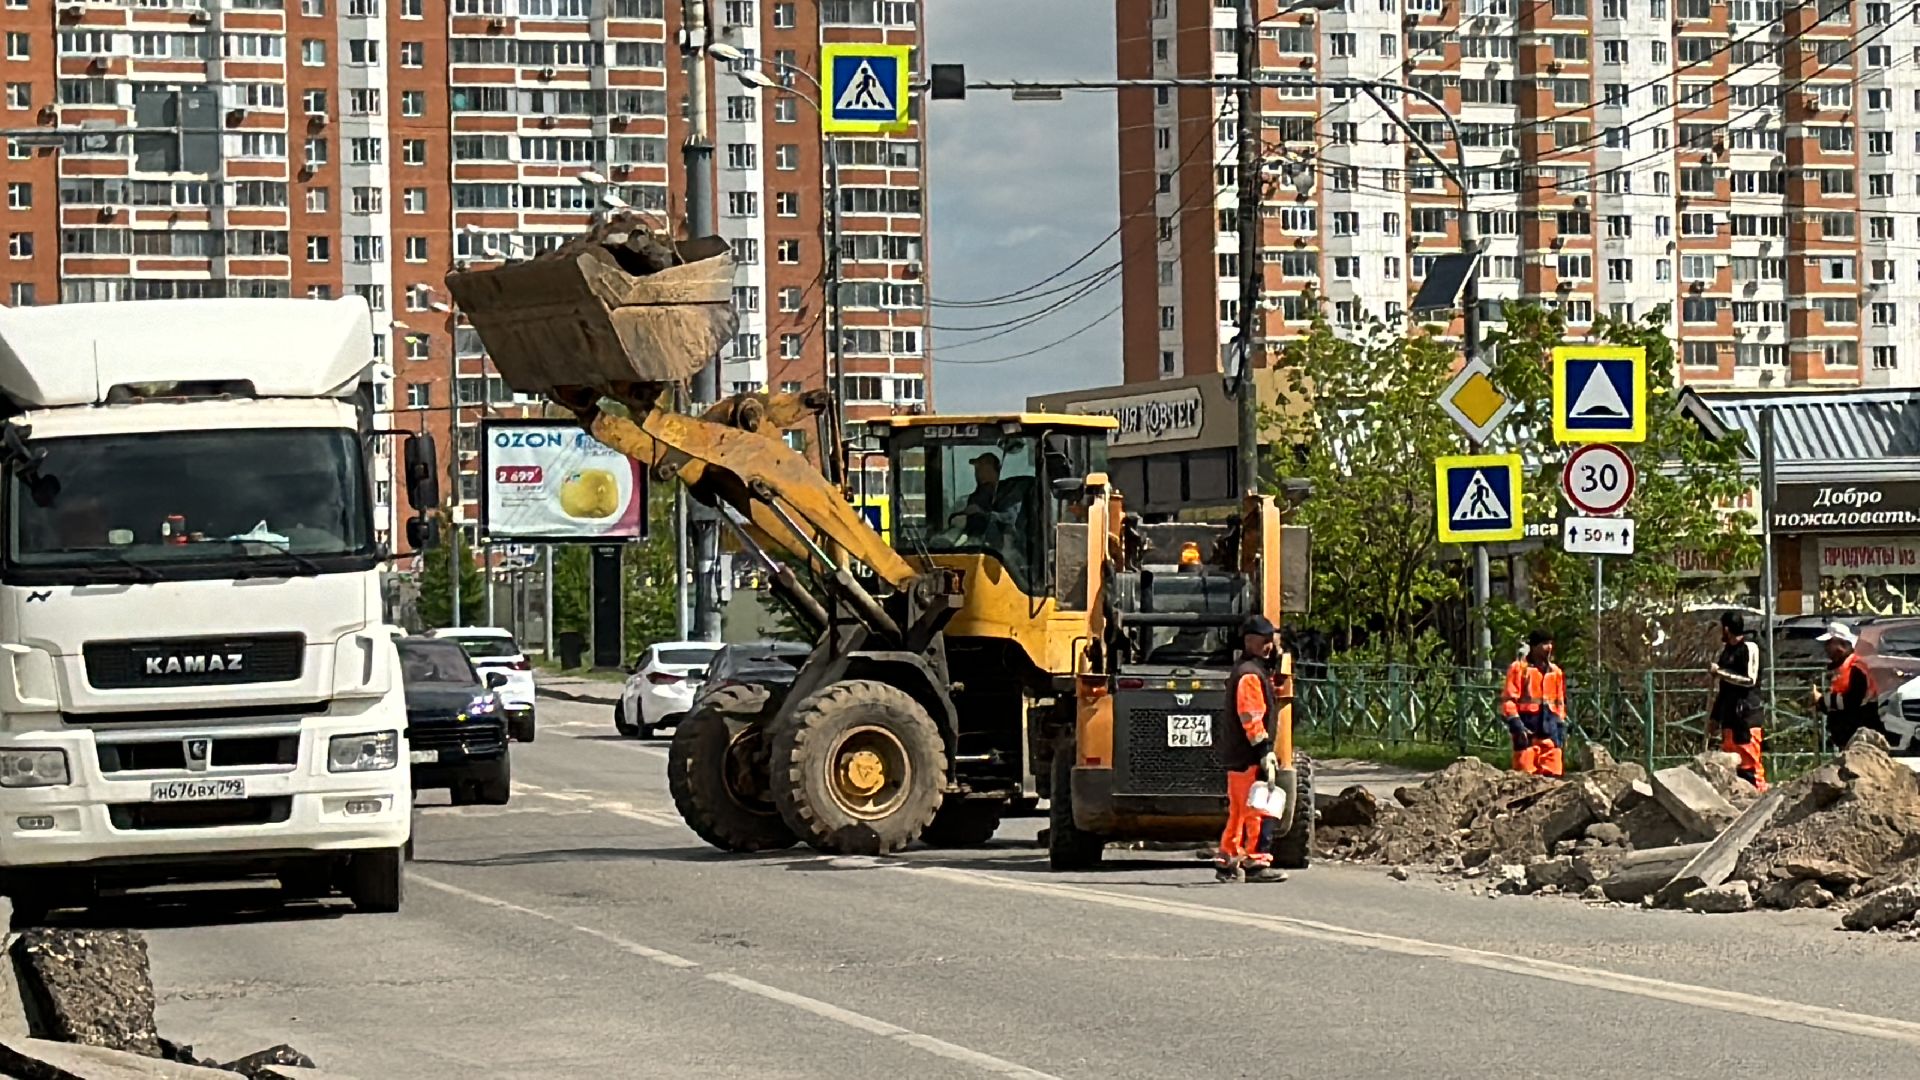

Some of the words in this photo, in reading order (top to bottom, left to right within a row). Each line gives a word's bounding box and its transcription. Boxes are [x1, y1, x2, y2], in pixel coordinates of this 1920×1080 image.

[495, 432, 562, 447] OZON
[924, 424, 979, 438] SDLG
[1581, 463, 1618, 492] 30
[1813, 487, 1882, 508] Добро
[1584, 528, 1602, 541] 50
[1824, 546, 1894, 568] ПРОДУКТЫ
[146, 653, 243, 674] KAMAZ
